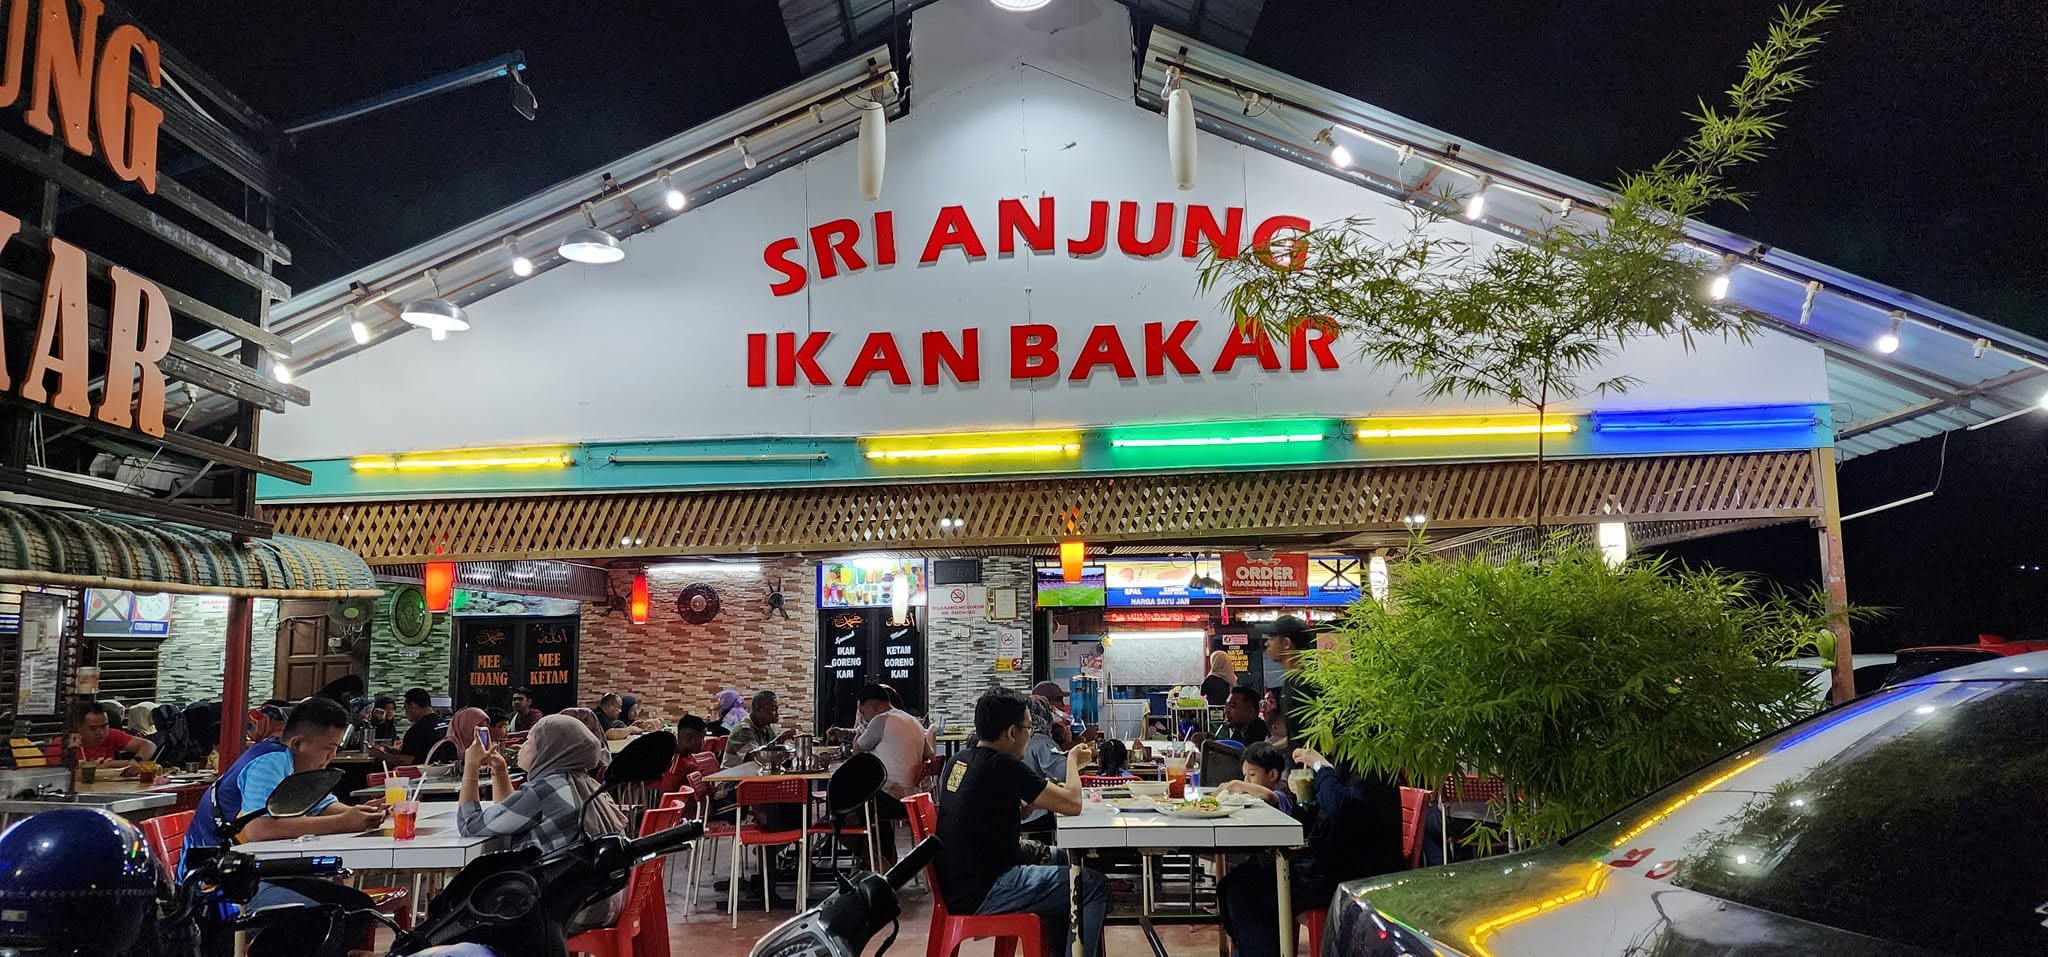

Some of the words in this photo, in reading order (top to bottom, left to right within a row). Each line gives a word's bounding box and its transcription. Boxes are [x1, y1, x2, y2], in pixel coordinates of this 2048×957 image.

[763, 210, 896, 297] SRI
[918, 195, 1311, 272] ANJUNG
[0, 210, 174, 438] AR
[747, 328, 981, 388] IKAN
[1010, 315, 1340, 381] BAKAR
[1235, 566, 1294, 580] ORDER
[837, 646, 856, 656] IKAN
[886, 645, 912, 656] KETAM
[478, 655, 500, 668] MEE
[538, 653, 560, 667] MEE
[831, 657, 862, 667] GORENG
[884, 657, 914, 667] GORENG
[470, 671, 509, 686] UDANG
[530, 670, 569, 685] KETAM
[836, 669, 854, 679] KARI
[890, 669, 909, 679] KARI
